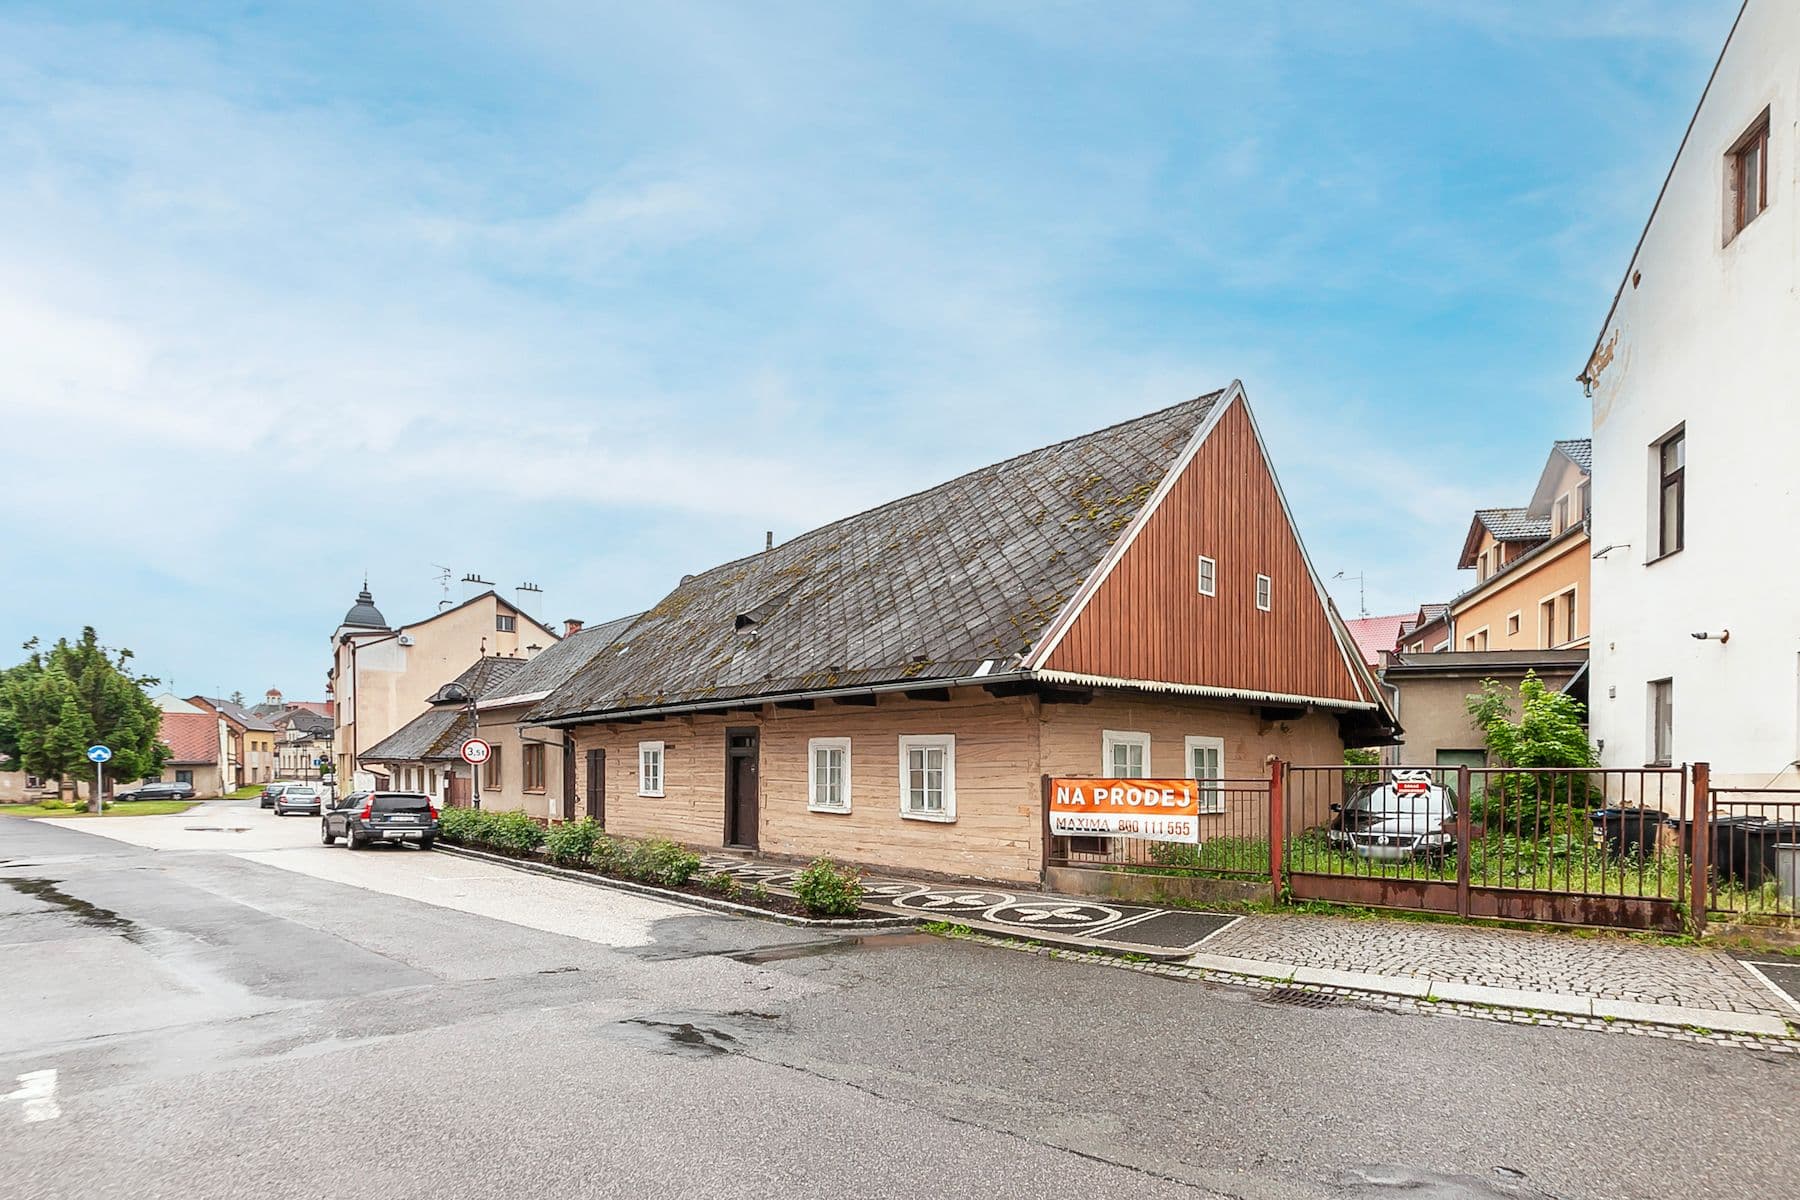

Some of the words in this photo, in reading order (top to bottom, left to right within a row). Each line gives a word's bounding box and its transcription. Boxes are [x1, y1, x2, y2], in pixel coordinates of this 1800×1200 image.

[1056, 787, 1086, 806] NA
[1094, 787, 1192, 808] PRODEJ
[1056, 817, 1110, 829] MAXIMA
[1118, 819, 1139, 833] 800
[1144, 820, 1164, 834] 111
[1167, 821, 1190, 836] 555
